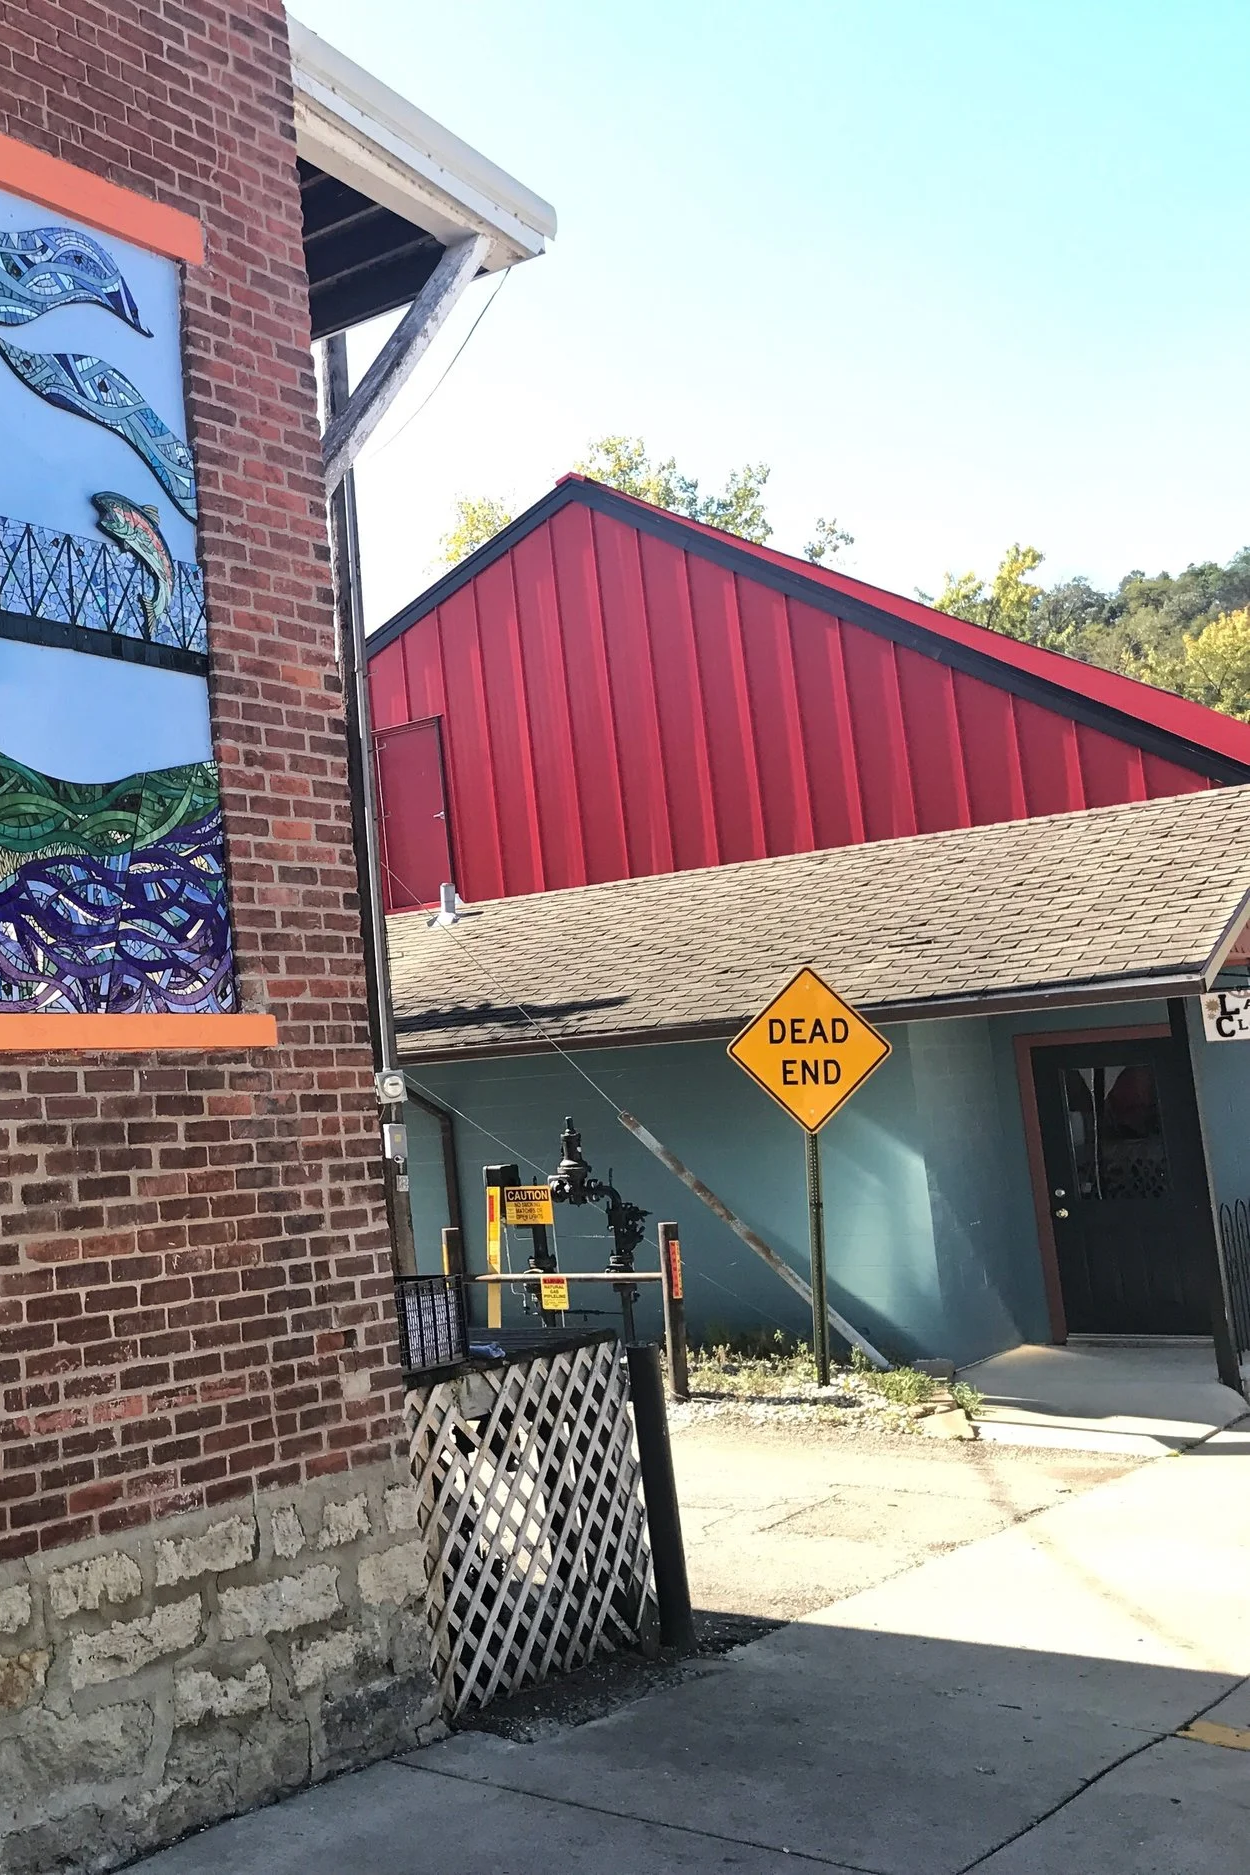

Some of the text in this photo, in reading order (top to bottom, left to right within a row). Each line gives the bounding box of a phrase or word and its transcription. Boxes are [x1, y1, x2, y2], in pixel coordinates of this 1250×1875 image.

[768, 1018, 849, 1044] DEAD
[781, 1060, 841, 1085] END
[507, 1190, 548, 1200] CAUTION
